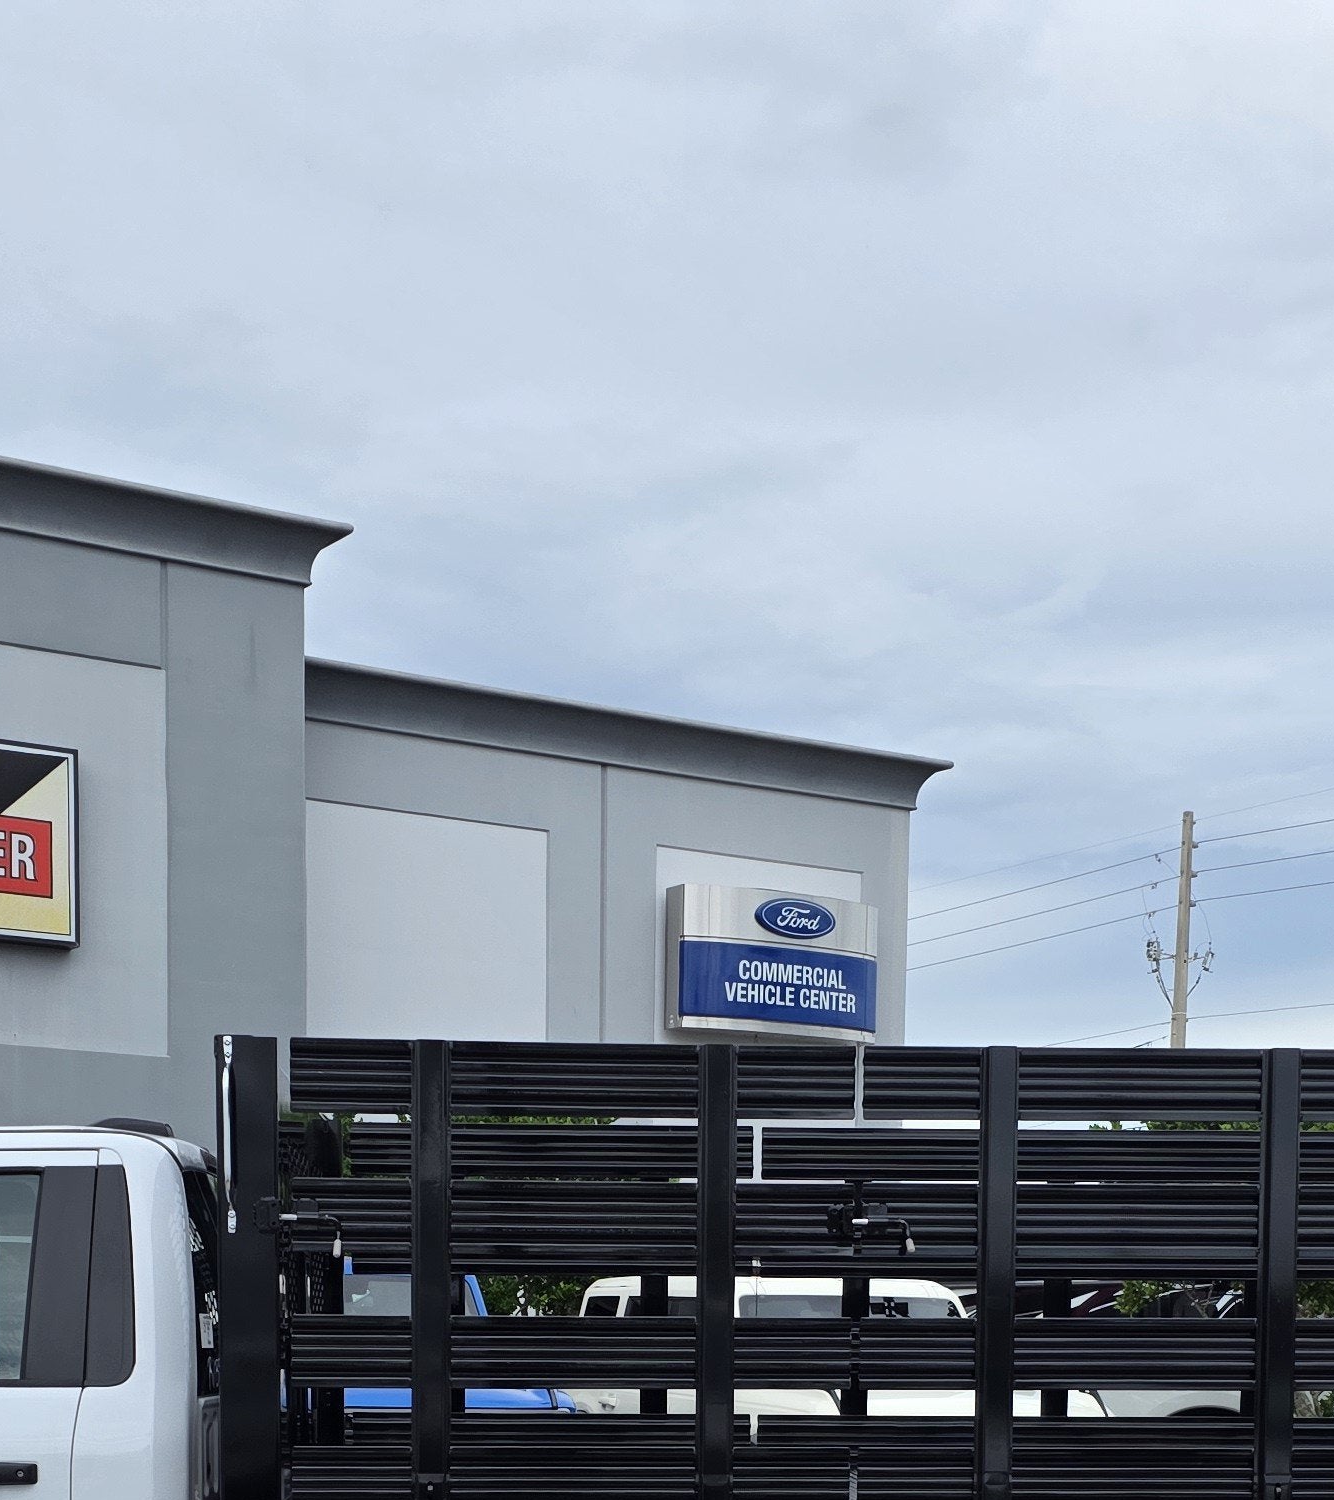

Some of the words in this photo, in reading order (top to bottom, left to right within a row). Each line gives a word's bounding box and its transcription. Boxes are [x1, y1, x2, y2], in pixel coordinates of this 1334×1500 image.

[776, 906, 820, 931] Ford
[738, 959, 847, 990] COMMERCIAL
[724, 981, 795, 1007] VEHICLE
[799, 988, 857, 1014] CENTER
